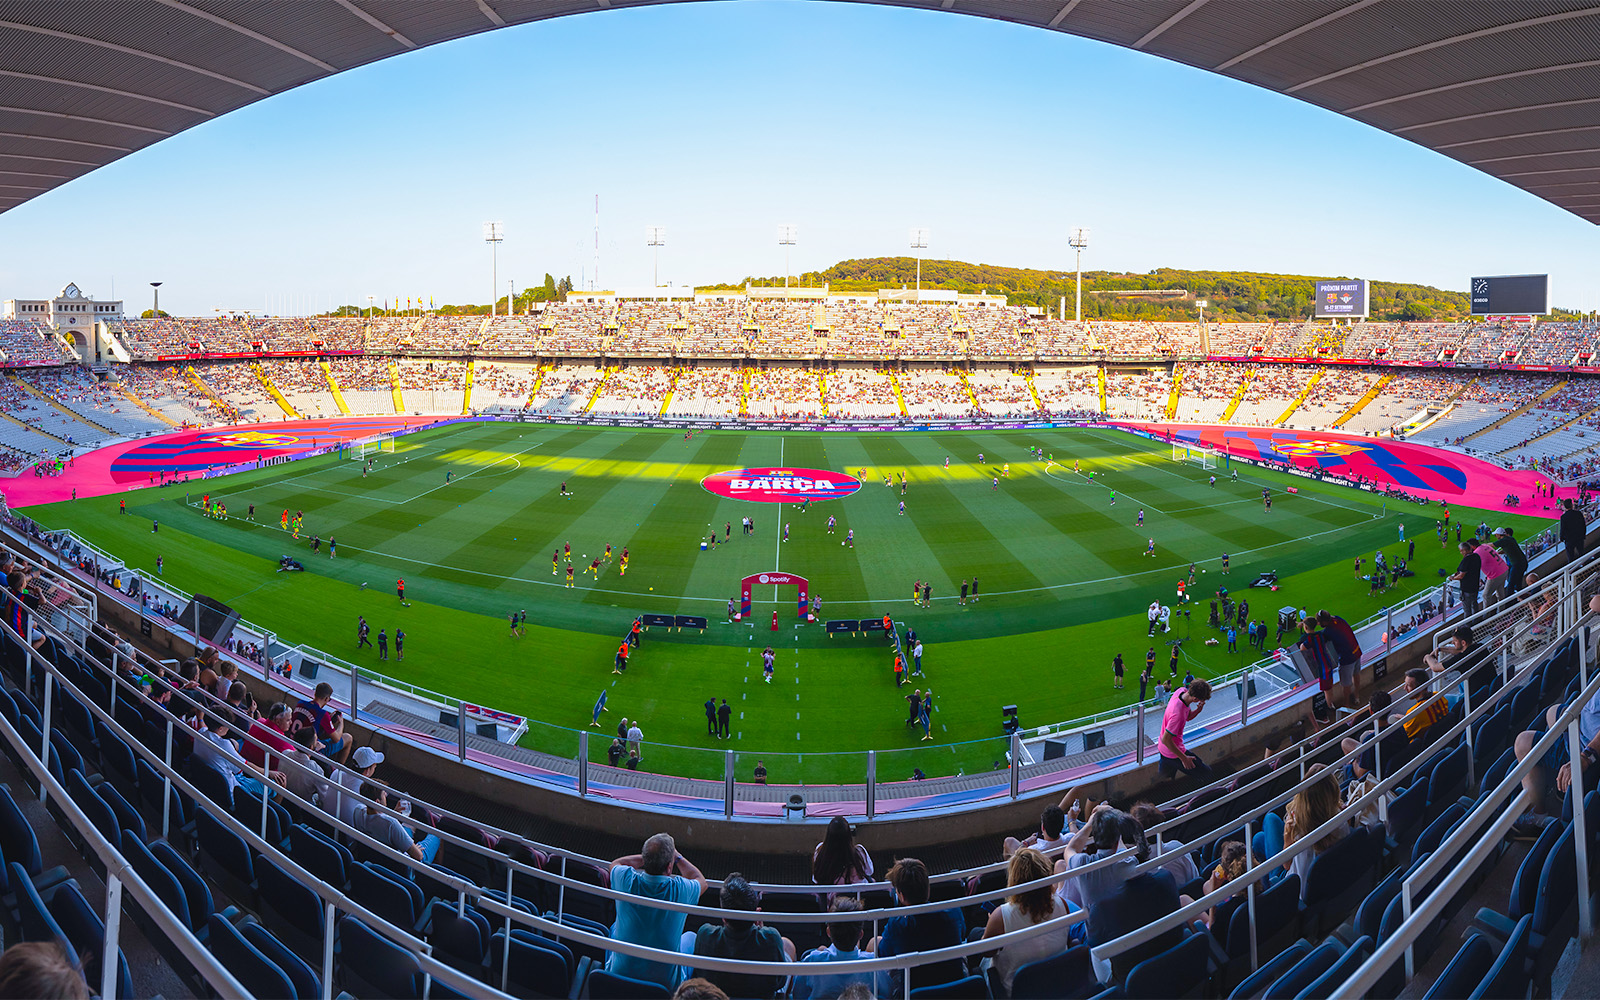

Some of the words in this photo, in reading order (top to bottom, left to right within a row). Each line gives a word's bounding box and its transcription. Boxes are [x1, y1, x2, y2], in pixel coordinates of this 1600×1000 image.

[1230, 455, 1248, 463] AMBILIGHT
[1288, 468, 1311, 478] AMBILIGHT
[1321, 475, 1348, 486] AMBILIGHT
[730, 480, 835, 492] BARÇA
